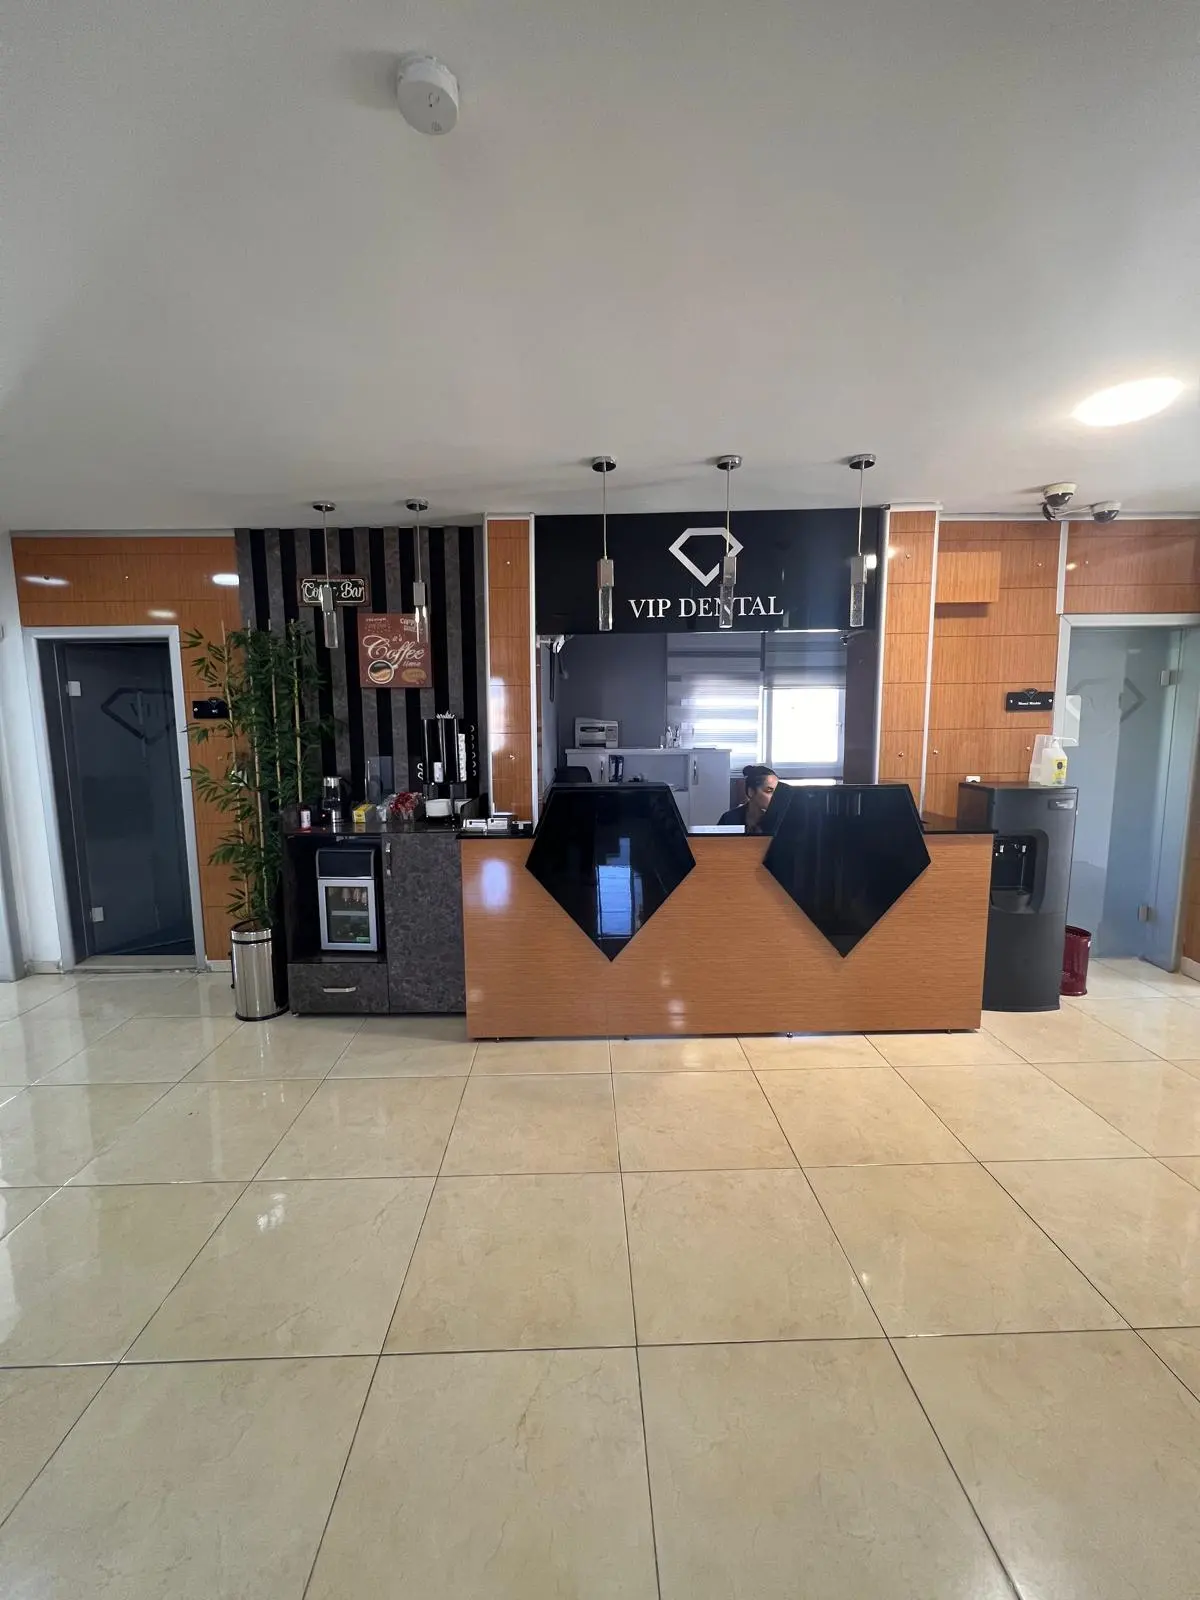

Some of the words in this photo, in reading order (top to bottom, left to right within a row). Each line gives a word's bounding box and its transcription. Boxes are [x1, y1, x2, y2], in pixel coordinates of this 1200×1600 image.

[340, 581, 364, 598] Bar
[628, 598, 671, 619] VIP
[363, 634, 425, 668] Coffee
